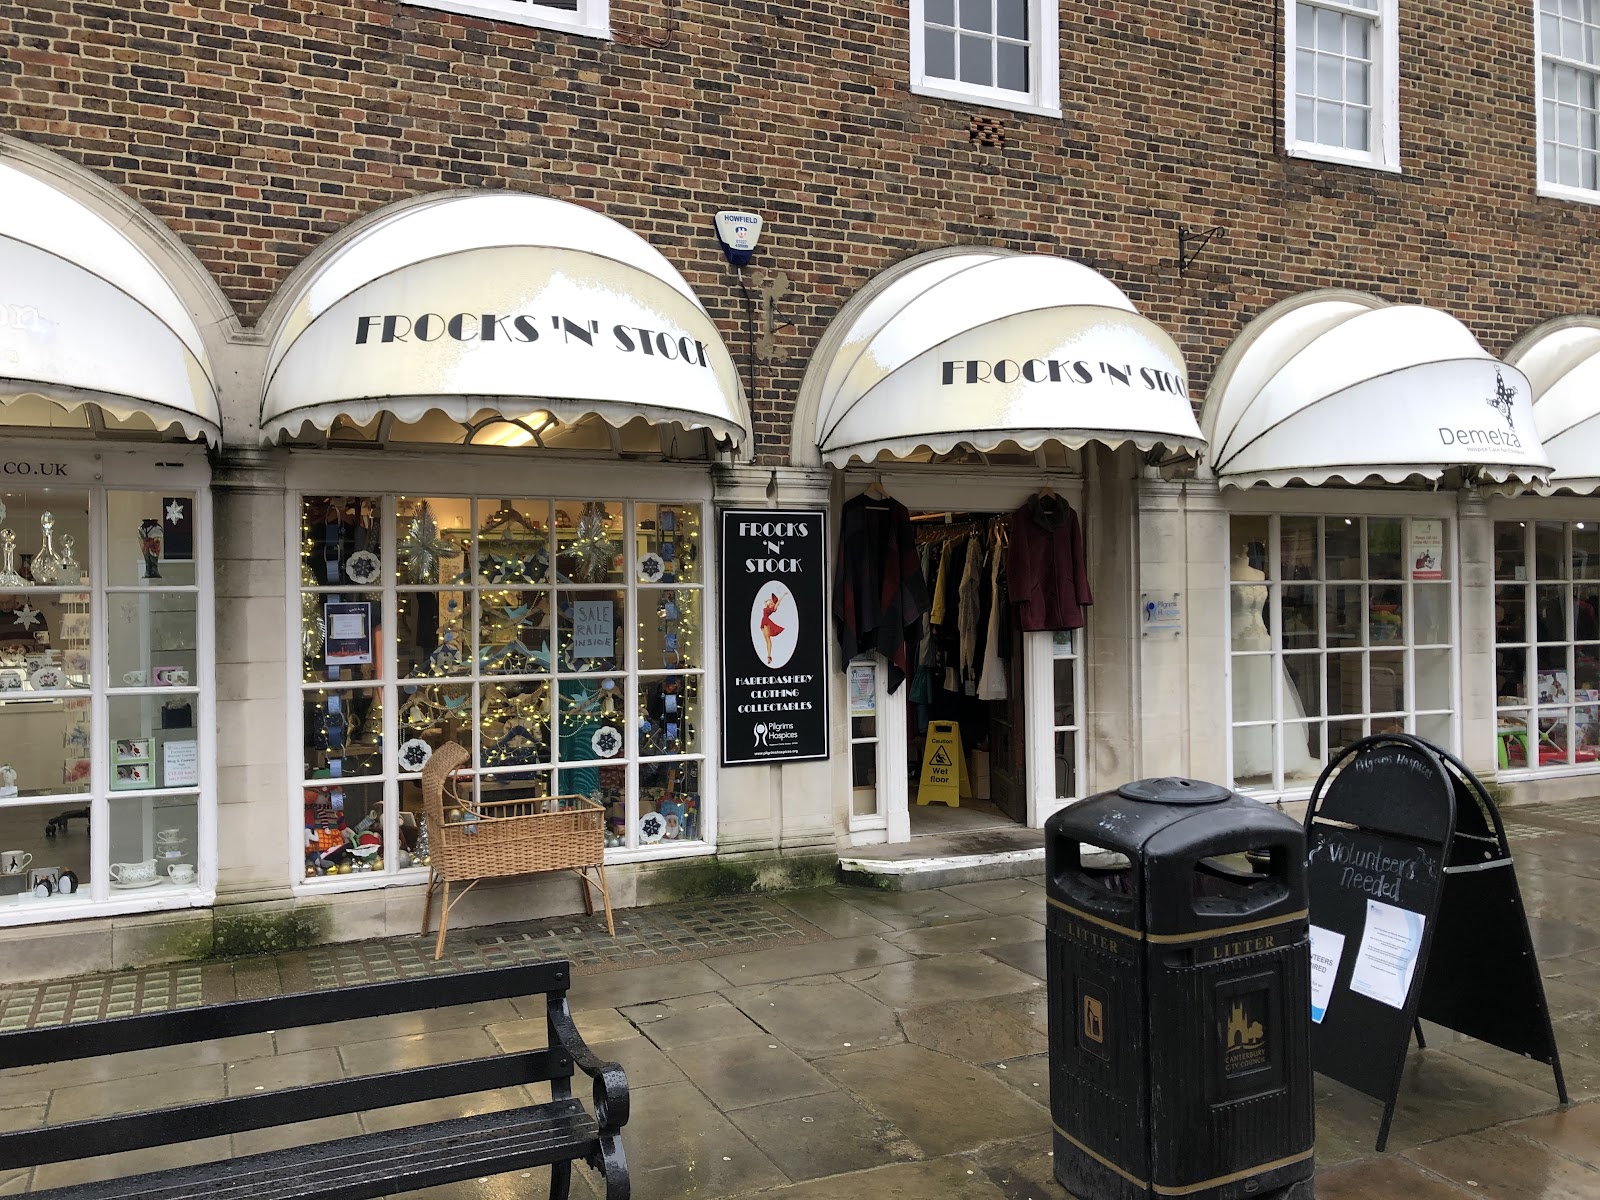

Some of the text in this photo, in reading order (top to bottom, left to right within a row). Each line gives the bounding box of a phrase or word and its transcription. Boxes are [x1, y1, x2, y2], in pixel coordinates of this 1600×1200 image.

[724, 215, 758, 223] HOWFIELD
[355, 312, 715, 372] FROCKS 'N' STOCK
[941, 358, 1093, 387] FROCKS
[1099, 361, 1133, 388] 'N'
[1438, 427, 1522, 448] Demelza
[739, 522, 809, 537] FROCKS
[745, 558, 803, 573] STOCK
[579, 606, 610, 623] SALE
[576, 624, 609, 636] RAIL
[575, 638, 611, 647] INSIDE
[735, 674, 814, 686] HABERDASHERY
[750, 688, 800, 699] CLOTHING
[737, 701, 813, 714] COLLECTABLES
[768, 722, 794, 732] Pilgrims
[768, 731, 799, 741] Hospices
[932, 767, 949, 775] Wet
[930, 775, 950, 783] floor
[1328, 842, 1416, 880] Volunteers
[1067, 922, 1118, 954] LITTER
[1212, 934, 1275, 960] LITTER
[1225, 1049, 1266, 1064] CANTERBURY
